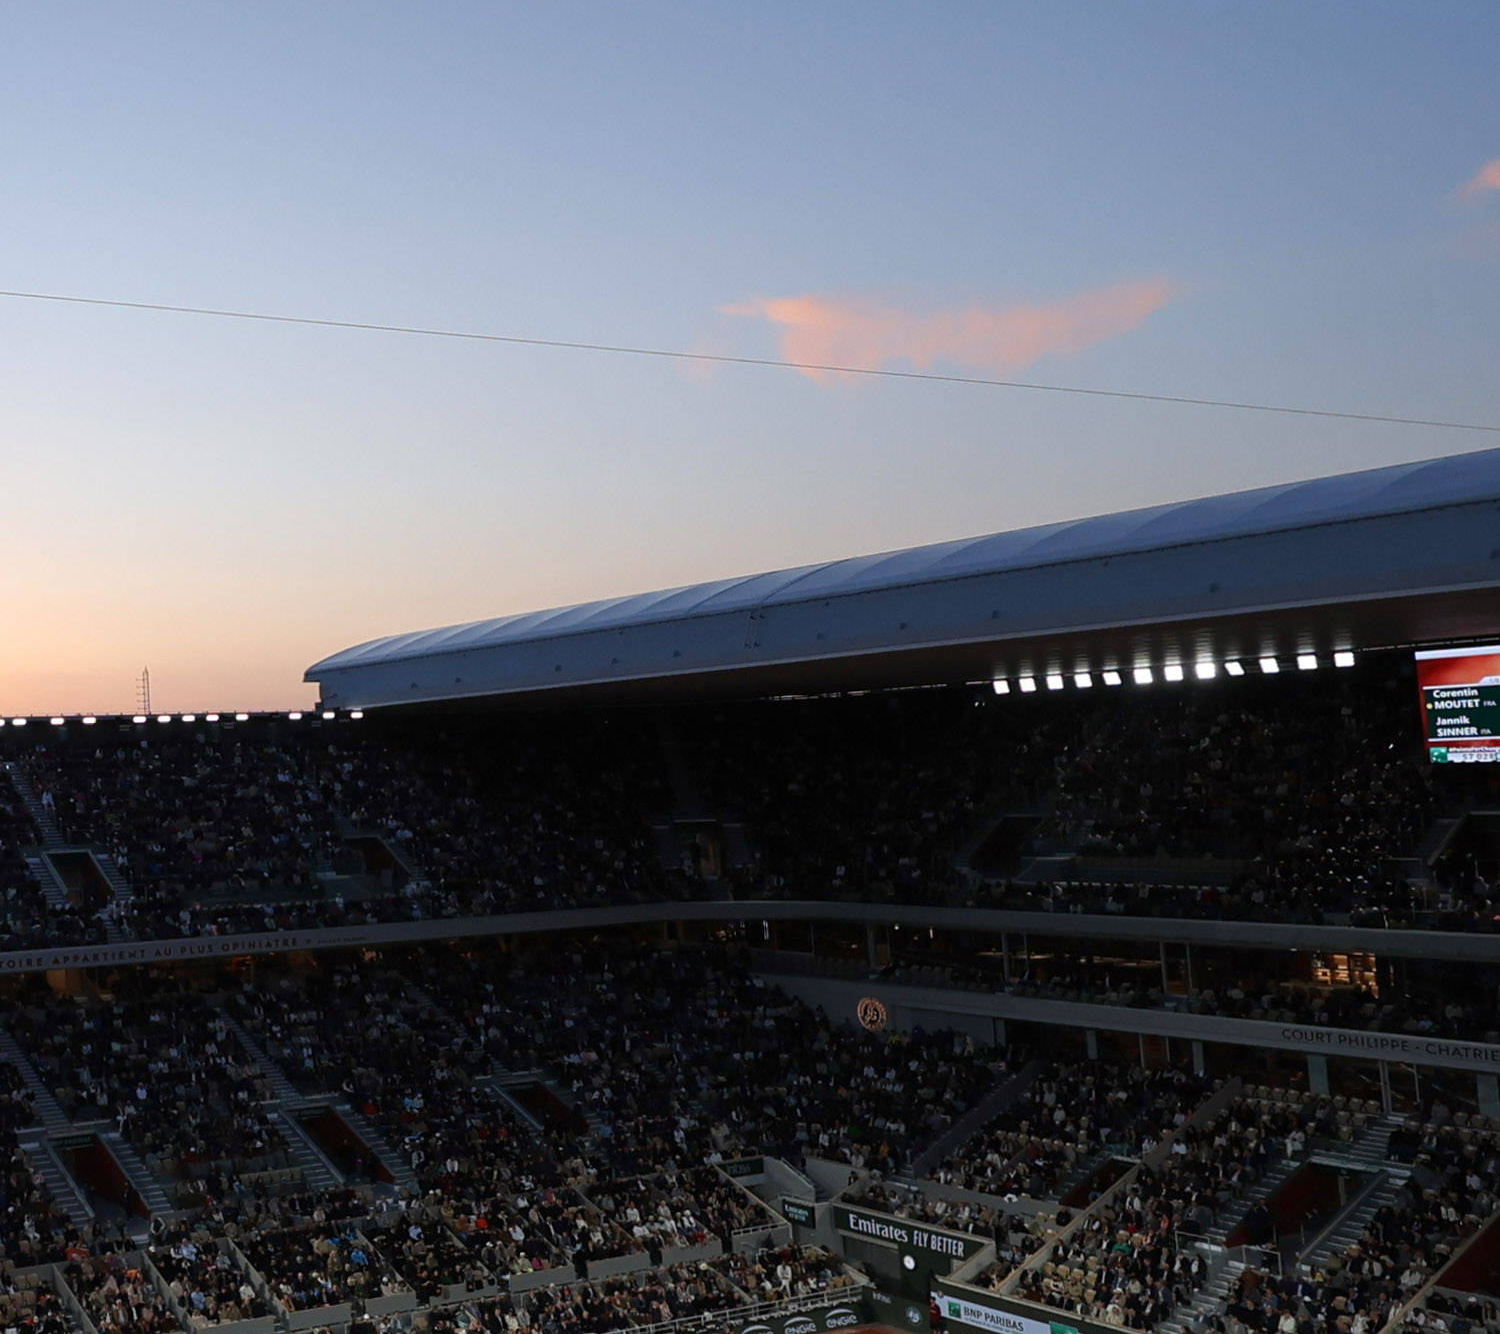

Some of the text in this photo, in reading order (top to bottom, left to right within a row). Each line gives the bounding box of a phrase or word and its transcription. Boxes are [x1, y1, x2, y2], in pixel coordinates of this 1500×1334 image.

[1433, 688, 1478, 698] Corentin
[1434, 698, 1480, 709] MOUTET
[1436, 715, 1470, 726] Jannik
[1437, 726, 1478, 737] SINNER
[52, 949, 145, 965] APPARTIENT
[155, 948, 171, 957] AU
[180, 944, 213, 955] PLUS
[1282, 1029, 1332, 1043] COURT
[1338, 1034, 1409, 1052] PHILIPPE
[848, 1213, 965, 1258] Emirates FLY BETTER
[964, 1306, 984, 1319] BNP
[984, 1312, 1024, 1332] PARIBAS
